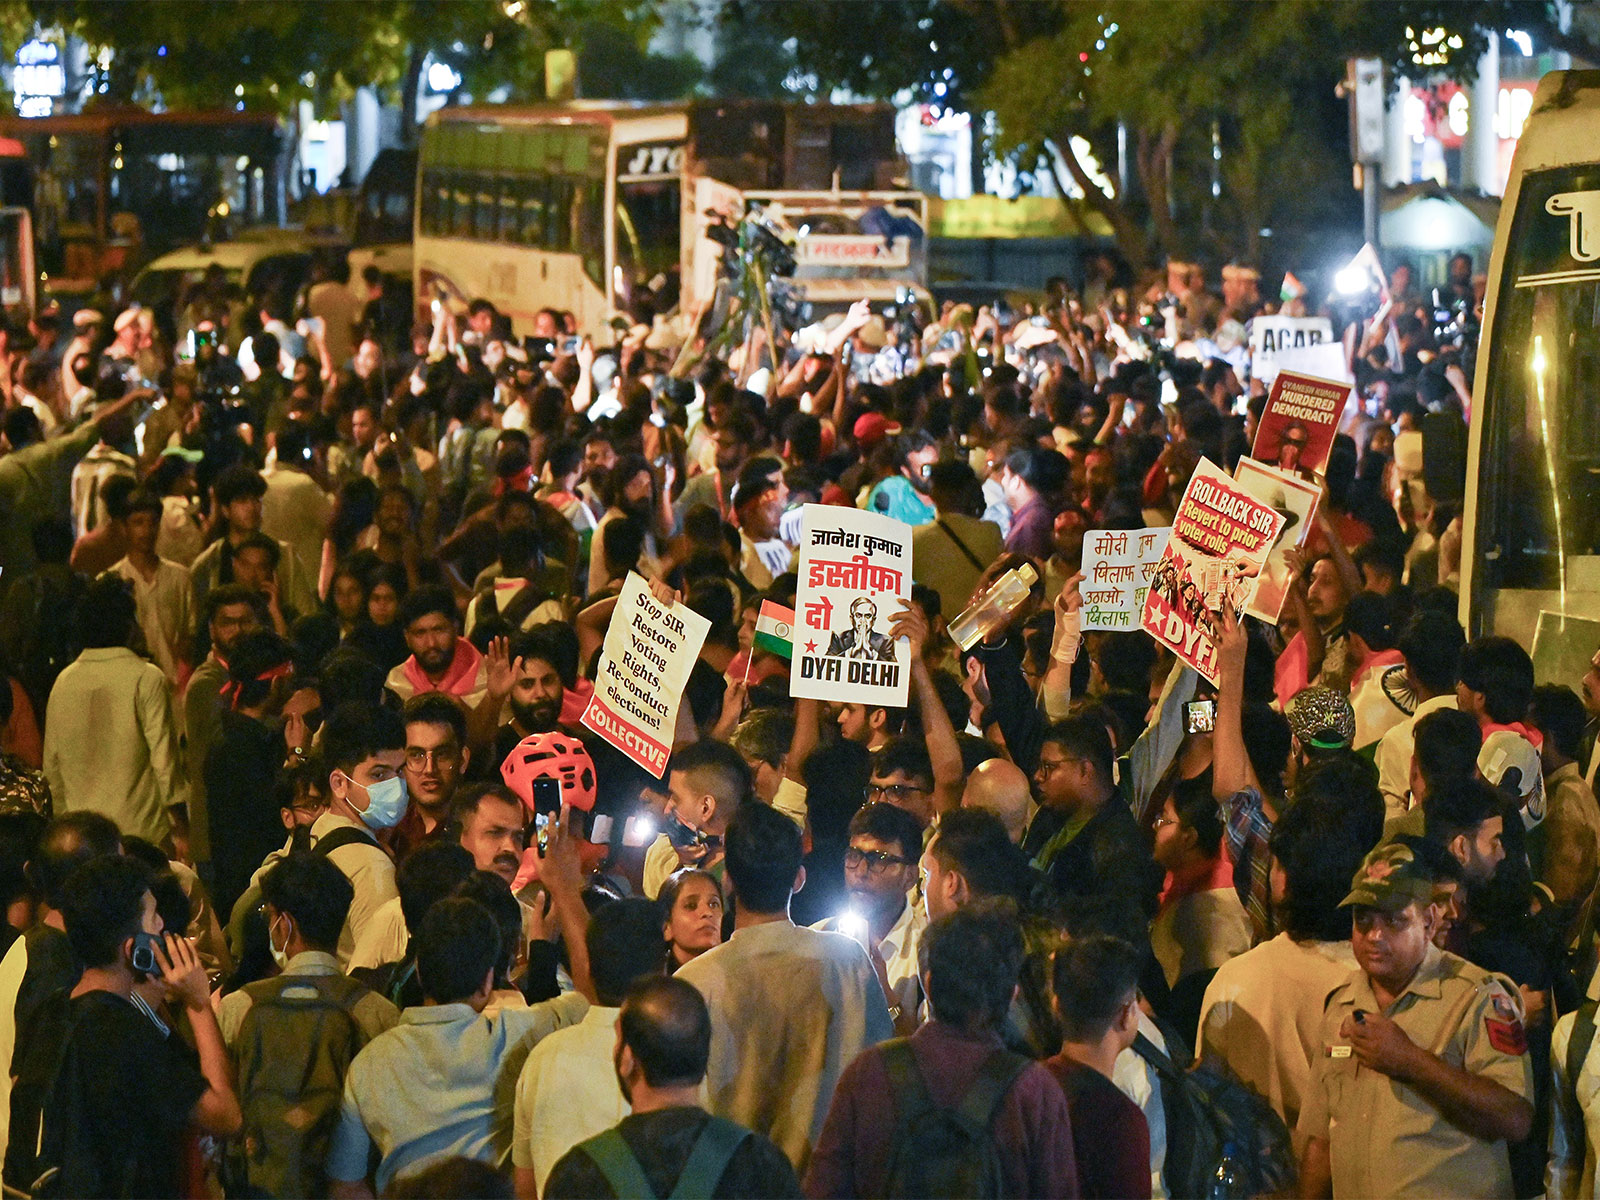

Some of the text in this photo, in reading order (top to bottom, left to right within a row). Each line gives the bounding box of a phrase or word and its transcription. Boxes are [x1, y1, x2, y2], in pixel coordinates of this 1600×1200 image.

[1279, 389, 1336, 412] MURDERED
[1282, 380, 1341, 401] GYANESH KUMAR
[1271, 401, 1335, 425] DEMOCRACY!
[1183, 500, 1259, 550] Revert to prior
[1190, 478, 1274, 541] ROLLBACK SIR,
[811, 527, 903, 558] ज्ञानेश कुमार
[1094, 532, 1128, 556] मोदी
[1179, 520, 1228, 555] voter rolls
[808, 555, 903, 596] इस्तीफ़ा
[632, 613, 677, 653] Restore
[636, 592, 687, 641] Stop SIR,
[804, 596, 834, 631] दो
[631, 634, 667, 672] Voting
[1164, 612, 1219, 670] DYFI
[606, 660, 669, 718] Re-conduct
[622, 650, 661, 692] Rights,
[800, 656, 900, 688] DYFI DELHI
[1196, 661, 1215, 678] DELHI
[607, 685, 661, 730] elections!
[589, 703, 666, 770] COLLECTIVE
